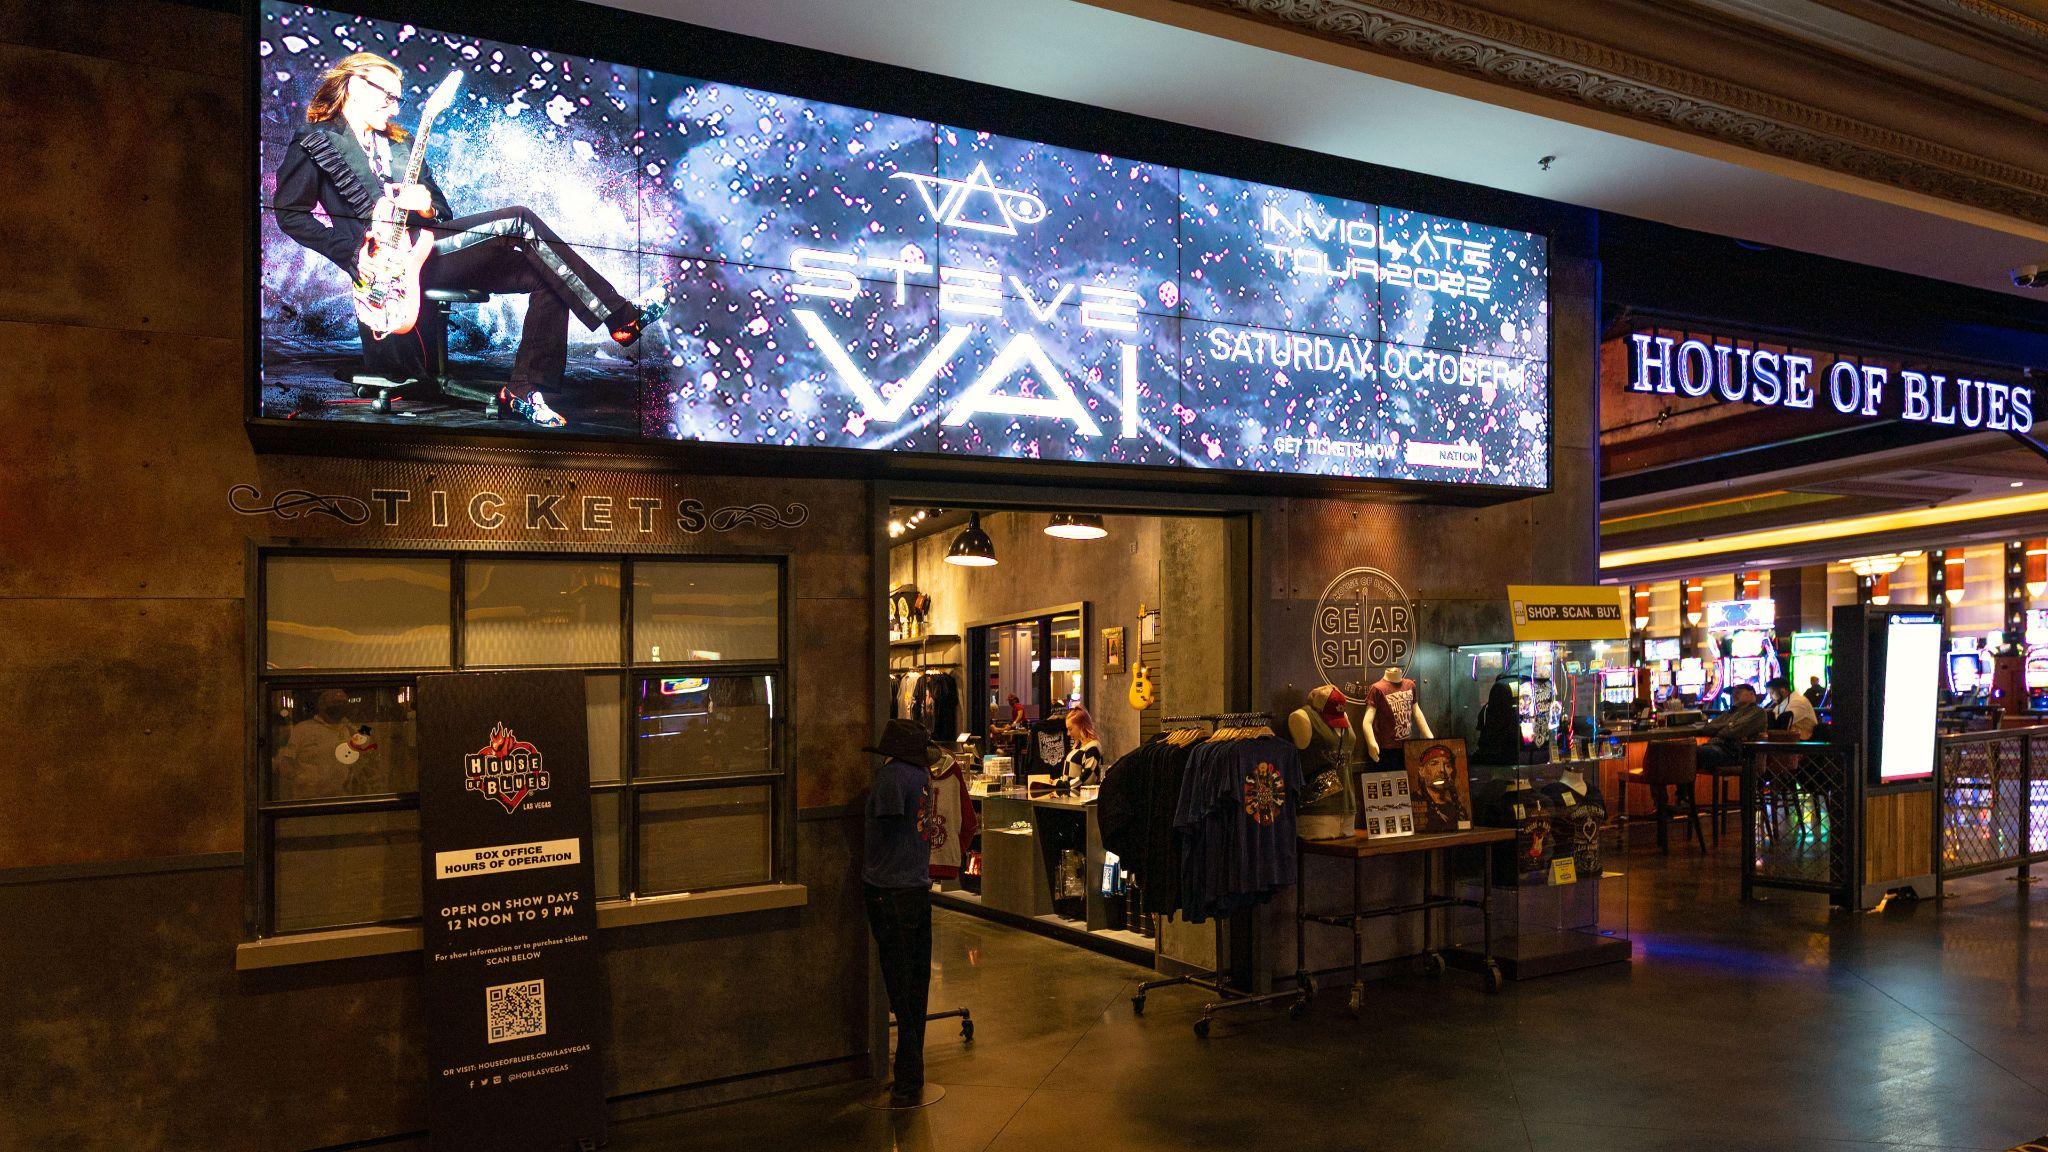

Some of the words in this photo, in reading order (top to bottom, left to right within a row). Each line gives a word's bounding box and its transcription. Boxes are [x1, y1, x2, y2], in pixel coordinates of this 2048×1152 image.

[1262, 243, 1382, 284] TOUR
[1386, 263, 1492, 301] 2022
[789, 247, 1139, 332] STEVE
[791, 308, 1138, 440] VAI
[1383, 347, 1511, 393] OCTOBER
[1631, 332, 1814, 409] HOUSE
[1829, 360, 1888, 416] OF
[1900, 370, 2033, 434] BLUES
[1273, 437, 1303, 455] GET
[1305, 439, 1363, 458] TICKETS
[1365, 442, 1398, 460] NOW
[1439, 450, 1479, 462] NATION
[371, 488, 707, 534] TICKETS
[1319, 606, 1409, 635] GEAR
[1528, 606, 1560, 618] SHOP.
[1562, 606, 1594, 618] SCAN.
[1597, 606, 1620, 618] BUY.
[1321, 638, 1408, 668] SHOP
[471, 758, 539, 774] HOUSE
[487, 776, 547, 795] BLUES
[535, 801, 551, 809] VEGAS
[445, 862, 486, 874] HOURS
[489, 859, 505, 869] OF
[508, 852, 572, 867] OPERATION
[475, 852, 498, 861] BOX
[502, 845, 543, 857] OFFICE
[441, 904, 477, 917] OPEN
[481, 901, 501, 912] ON
[505, 896, 542, 909] SHOW
[547, 891, 579, 904] DAYS
[447, 919, 462, 931] 12
[467, 913, 512, 928] NOON
[517, 910, 536, 922] TO
[541, 908, 549, 919] 9
[554, 905, 574, 917] PM
[435, 954, 448, 962] For
[449, 951, 468, 960] show
[469, 945, 512, 957] information
[513, 943, 522, 951] or
[523, 942, 531, 950] to
[532, 938, 563, 950] purchase
[564, 934, 588, 943] tickets
[486, 956, 510, 966] SCAN
[511, 951, 541, 963] BELOW
[443, 1068, 455, 1077] OR
[456, 1064, 477, 1075] VISIT:
[478, 1043, 591, 1070] HOUSEOFBLUES.COM/LASVEGAS
[508, 1064, 569, 1083] @HOBLASVEGAS
